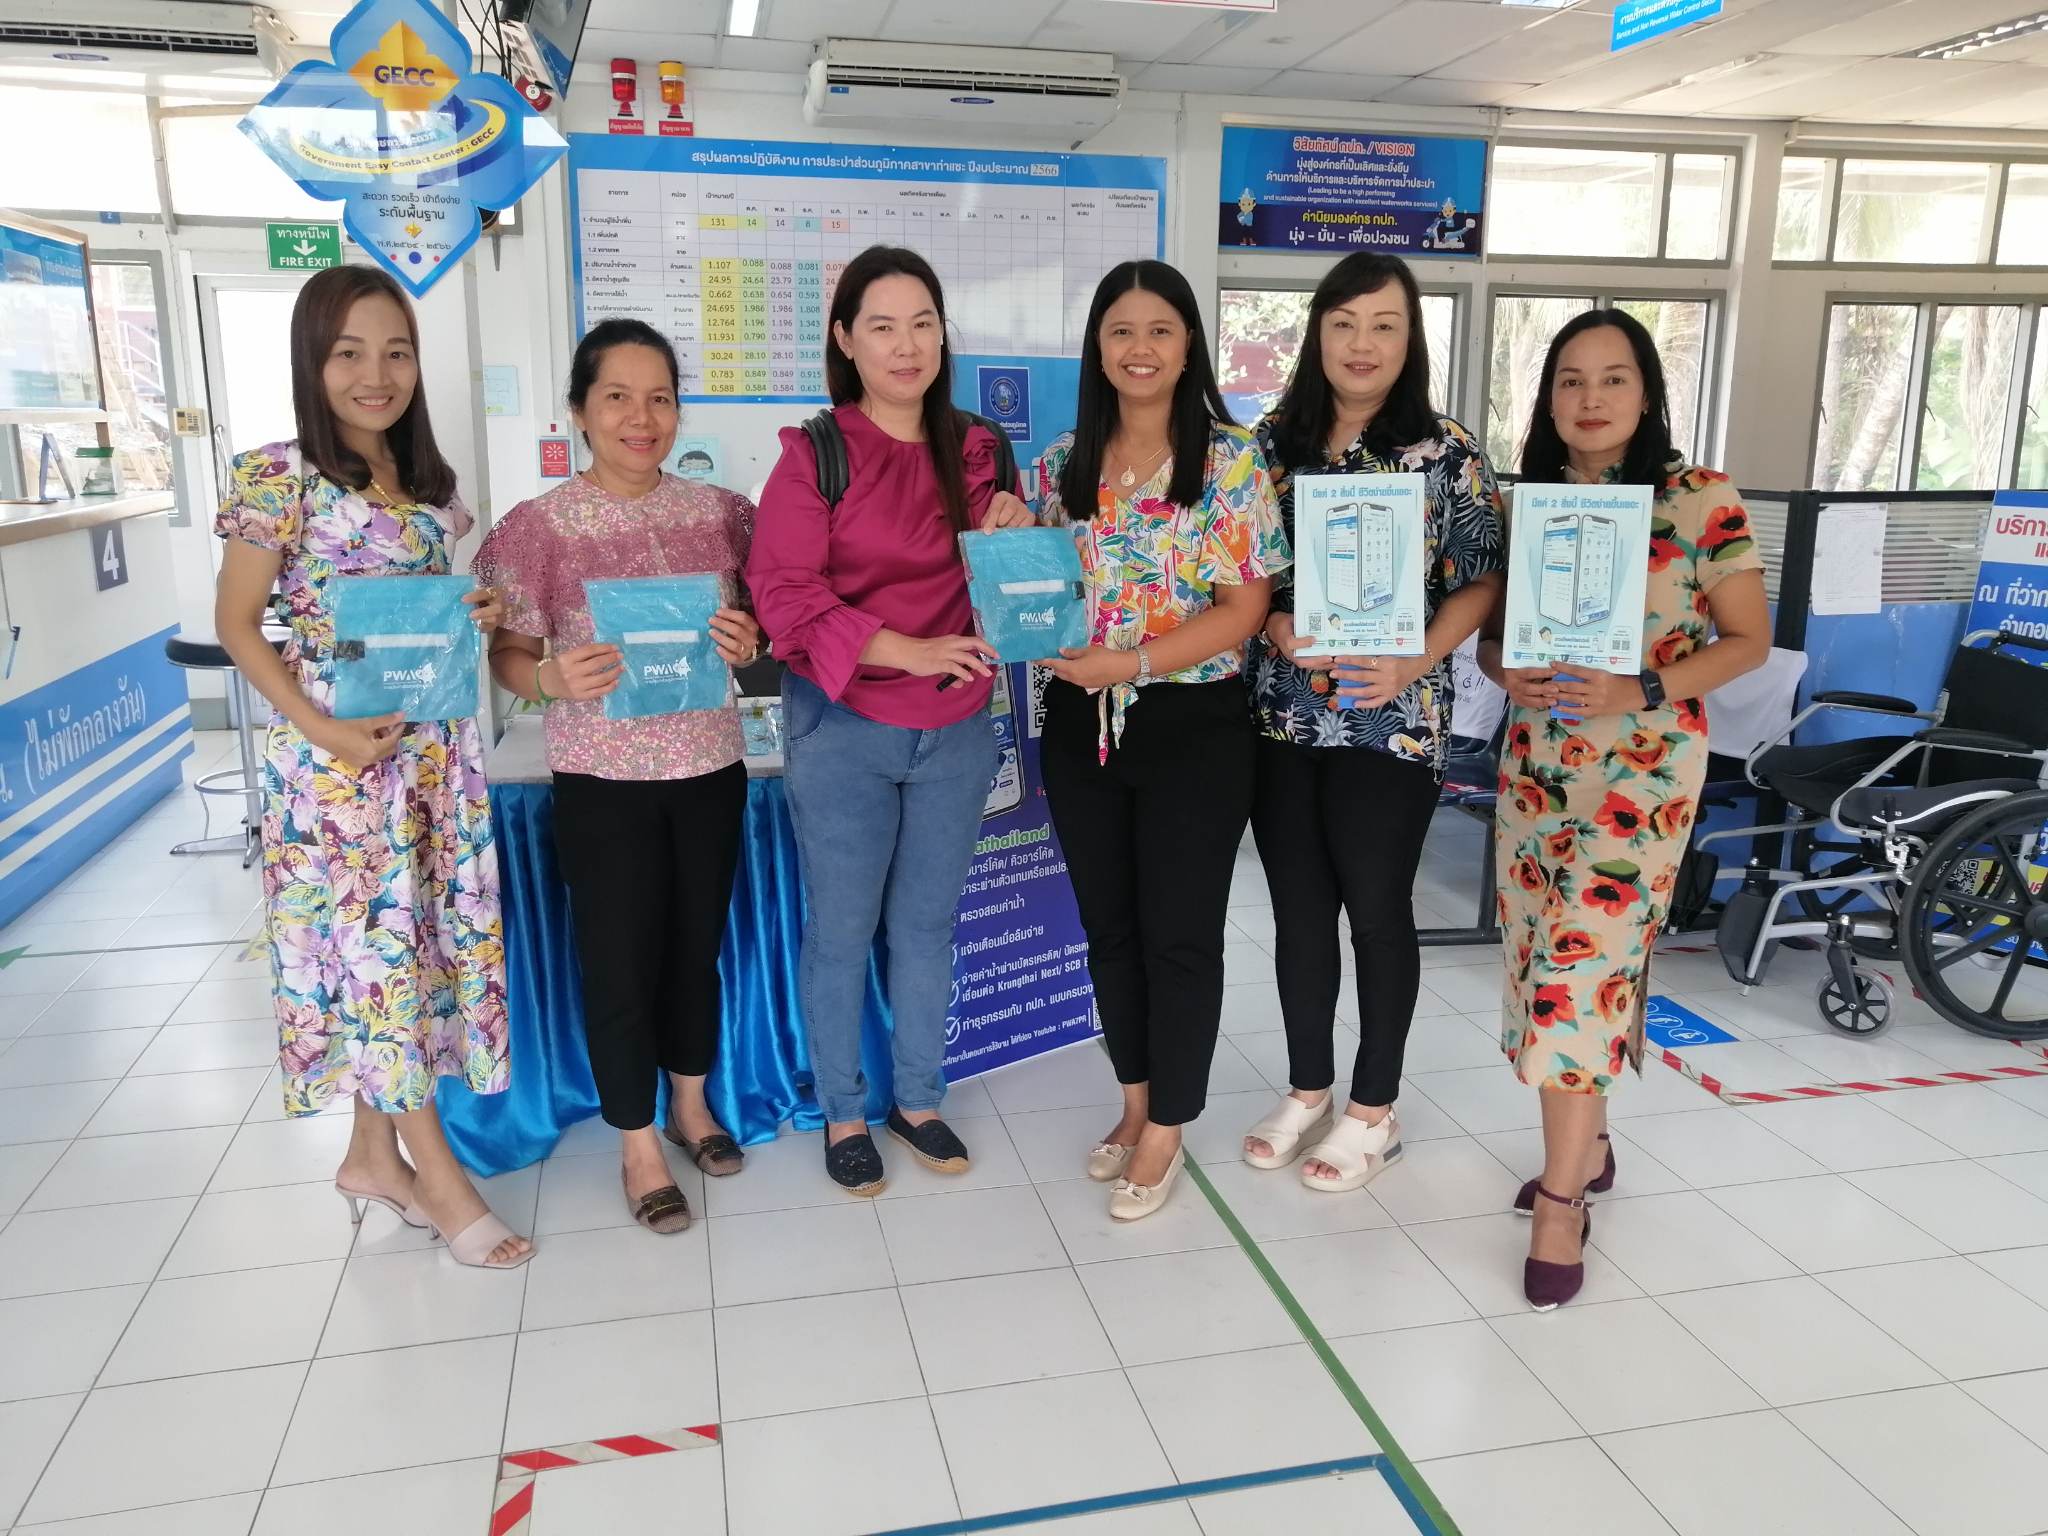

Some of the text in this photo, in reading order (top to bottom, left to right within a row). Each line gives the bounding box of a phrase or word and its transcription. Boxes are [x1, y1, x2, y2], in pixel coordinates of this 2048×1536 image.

[374, 65, 435, 87] GECC
[365, 162, 389, 176] Easy
[392, 156, 430, 168] Contact
[433, 147, 464, 161] Center
[471, 128, 495, 147] GECC
[1293, 136, 1339, 152] วิสัยทัศน์
[1375, 143, 1415, 157] VISION
[691, 151, 1059, 176] สรุปผลการปฏิบัติงาน การประปาส่วนภูมิภาคสาขาท่าแซะ ปีงบประมาณ 2566
[1297, 157, 1410, 174] มุ่งสู่องค์กรที่เป็นเลิศและยั่งยืน
[1266, 170, 1435, 189] ด้านการให้บริการและบริหารจัดการน้ำประปา
[391, 192, 420, 202] รวดเร็ว
[379, 204, 446, 222] ระดับพื้นฐาน
[1303, 209, 1371, 224] ค่านิยมองค์กร
[711, 218, 726, 226] 131
[747, 218, 757, 226] 14
[832, 221, 841, 229] 15
[276, 227, 330, 240] ทางหนีไฟ
[1289, 224, 1410, 245] มุ่ง มั่น เพื่อปวงชน
[280, 256, 333, 268] FIRE EXIT
[708, 261, 731, 270] 1.107
[742, 259, 764, 267] 0.088
[770, 262, 792, 270] 0.088
[798, 263, 819, 271] 0.081
[708, 275, 732, 285] 24.95
[742, 276, 764, 285] 24.64
[770, 276, 792, 285] 23.79
[708, 289, 732, 298] 0.662
[770, 290, 792, 299] 0.654
[798, 291, 820, 300] 0.593
[707, 304, 735, 313] 24.695
[744, 304, 765, 313] 1.986
[772, 305, 793, 313] 1.986
[708, 319, 735, 328] 12.764
[744, 318, 765, 327] 1.196
[772, 319, 793, 328] 1.196
[708, 332, 821, 342] 11.931 0.790 0.790 0.464
[711, 352, 733, 361] 30.24
[772, 352, 794, 360] 28.10
[711, 370, 734, 379] 0.783
[772, 370, 794, 378] 0.849
[800, 370, 822, 379] 0.915
[711, 384, 734, 393] 0.588
[745, 384, 767, 392] 0.584
[772, 384, 794, 392] 0.584
[1331, 489, 1337, 498] 2
[1551, 499, 1558, 508] 2
[101, 529, 120, 581] 4
[2035, 543, 2048, 558] แ
[1978, 584, 1999, 603] ณ
[1019, 611, 1045, 624] PWA
[383, 670, 417, 682] PWA
[643, 663, 674, 677] PWA
[24, 675, 146, 796] (ไม่พักกลางวัน)
[974, 822, 1050, 856] athailand
[1011, 846, 1054, 867] คิวอาร์โค้ด
[960, 893, 1025, 923] ตรวจสอบค่าน้ำ
[961, 925, 1044, 956] แจ้งเตือนเมื่อลืมจ่าย
[962, 941, 1089, 985] จ่ายค่าน้ำผ่านบัตรเครดิต/ บัตรเด
[962, 985, 995, 1002] เชื่อมต่อ
[997, 971, 1038, 992] Krungthai
[1064, 959, 1081, 973] SCB
[962, 1003, 1022, 1031] ทำธุรกรรมกับ
[1050, 983, 1094, 1005] แบบครบวง
[1033, 1025, 1057, 1038] Youtube
